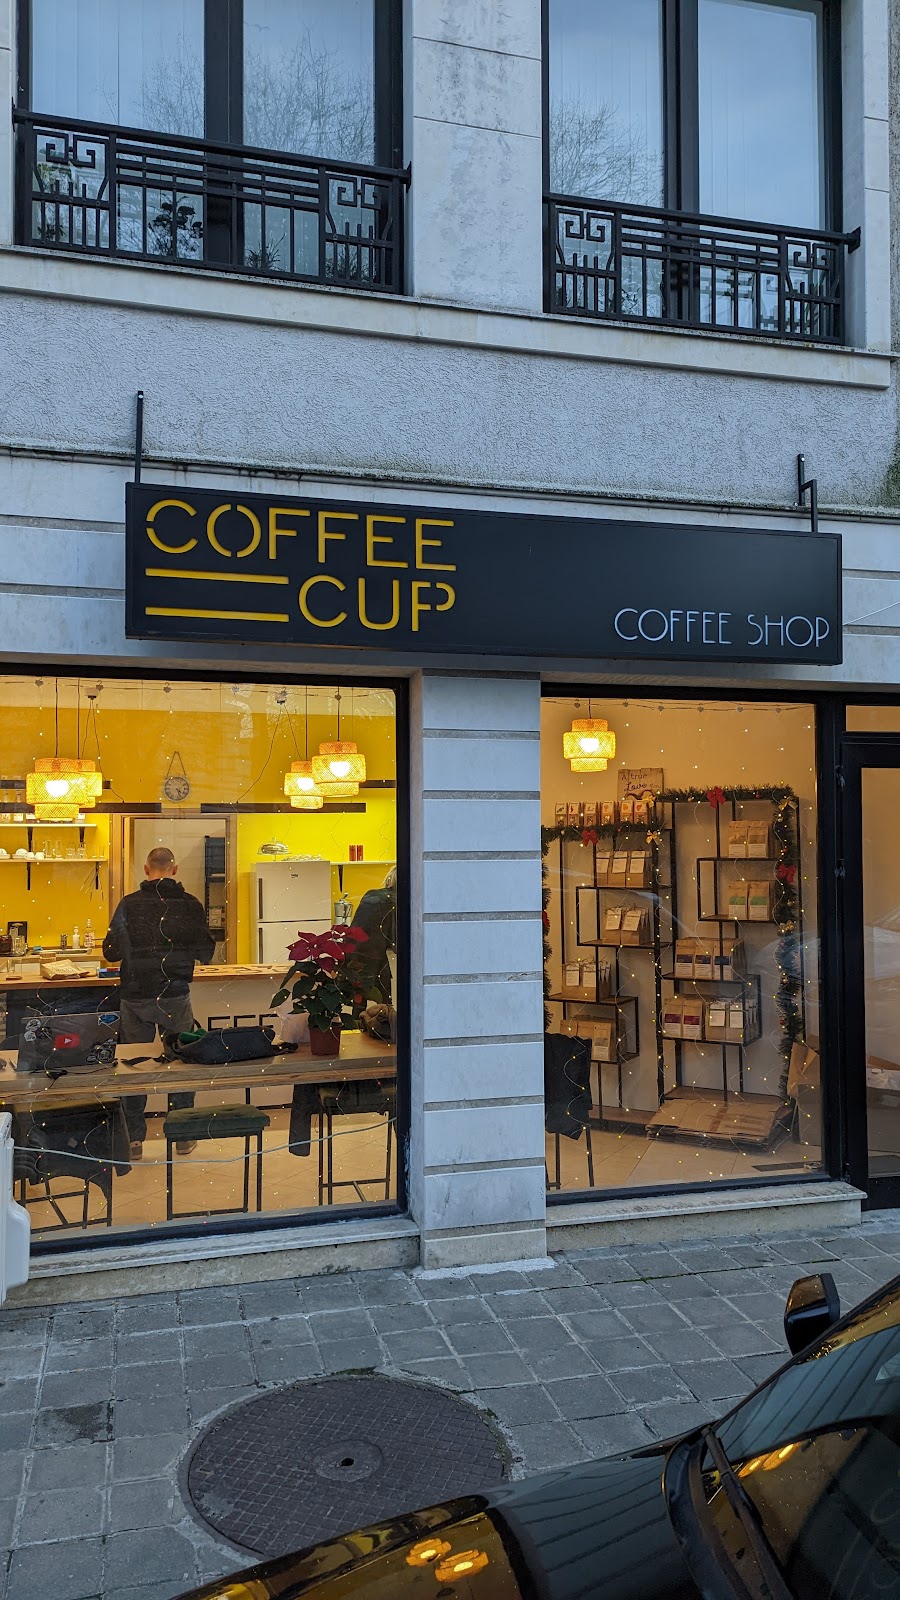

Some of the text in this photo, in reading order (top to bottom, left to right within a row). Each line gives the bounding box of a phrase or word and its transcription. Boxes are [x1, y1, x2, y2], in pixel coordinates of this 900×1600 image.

[146, 499, 457, 571] COFFEE
[298, 574, 456, 632] CUP
[614, 607, 830, 648] COFFEE SHOP
